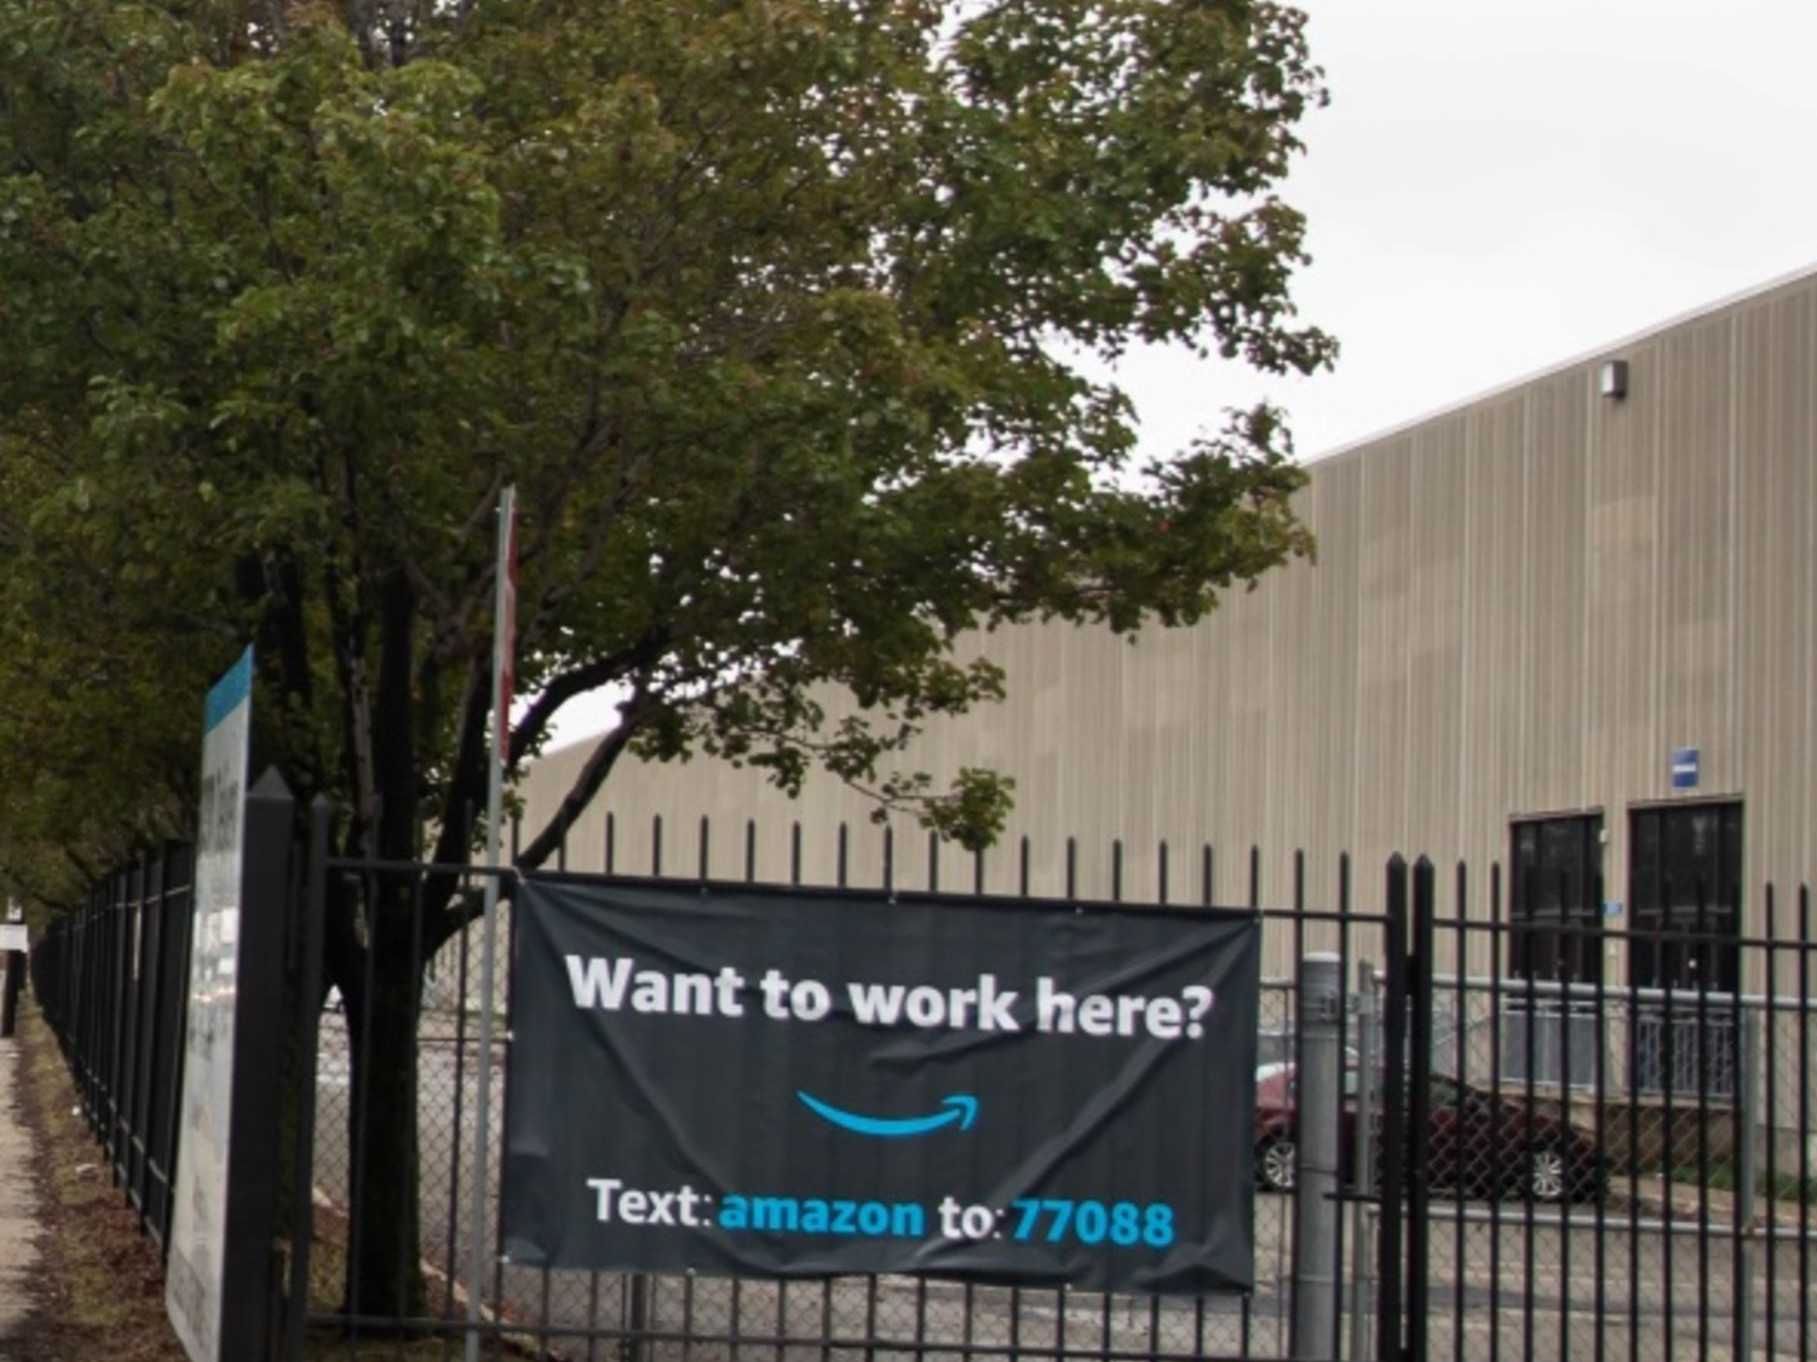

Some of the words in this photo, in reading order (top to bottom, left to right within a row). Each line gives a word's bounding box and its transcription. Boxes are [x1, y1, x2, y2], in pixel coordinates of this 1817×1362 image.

[564, 954, 745, 1018] Want
[759, 969, 832, 1022] to
[847, 973, 1021, 1032] work
[1035, 976, 1214, 1039] here?
[586, 1178, 713, 1227] Text:
[718, 1194, 924, 1235] amazon
[937, 1195, 1004, 1239] to:
[1011, 1199, 1176, 1247] 77088
